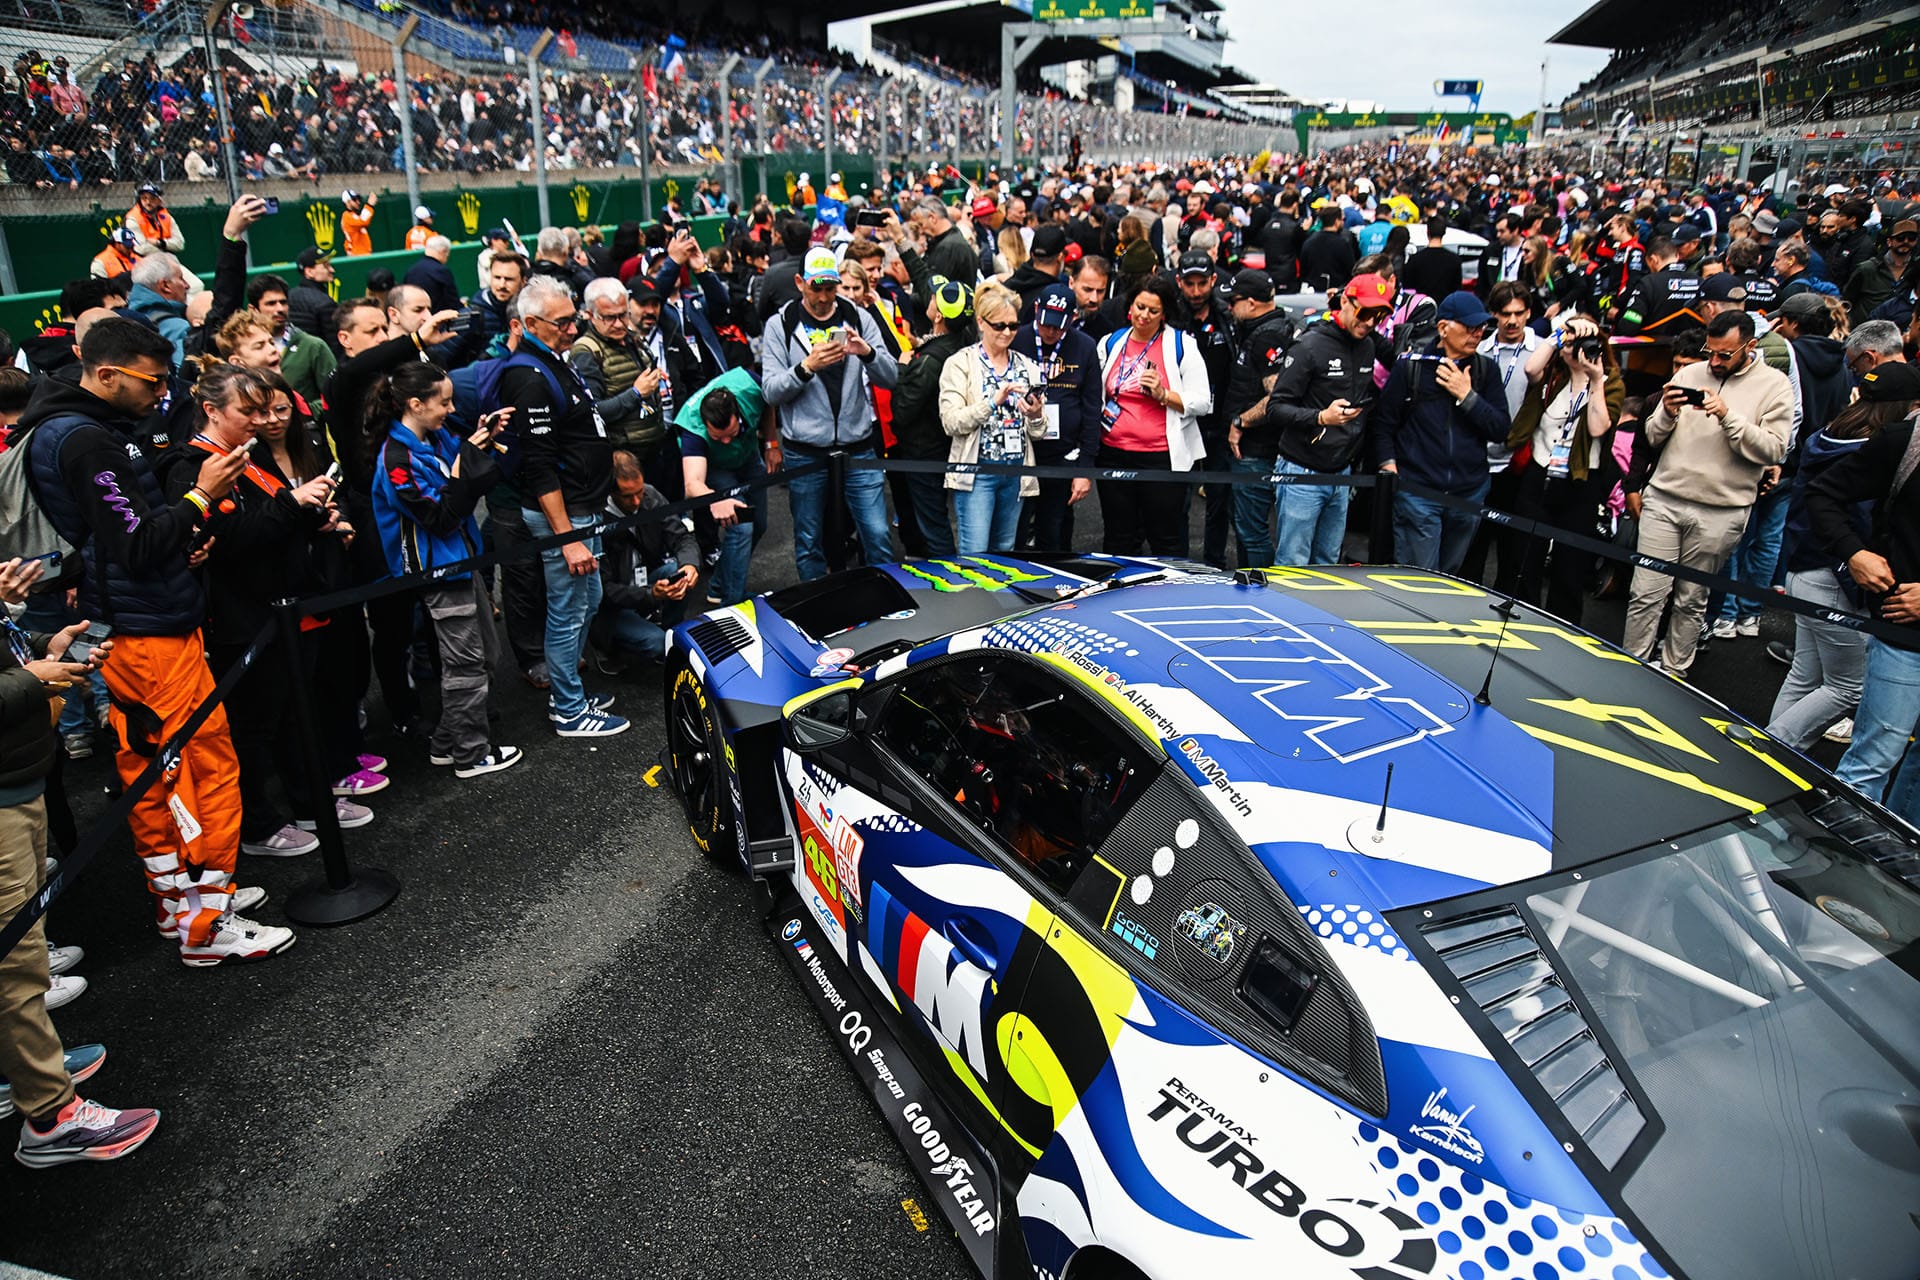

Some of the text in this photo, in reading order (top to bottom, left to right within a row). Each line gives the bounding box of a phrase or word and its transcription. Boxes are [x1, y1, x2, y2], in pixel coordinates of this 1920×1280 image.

[1111, 471, 1138, 479] WRT
[804, 835, 838, 902] 46
[839, 827, 858, 866] LM
[837, 854, 859, 896] GT3
[1116, 911, 1159, 949] GoPro
[807, 956, 848, 1011] Motorsport
[840, 1011, 872, 1056] OQ
[867, 1048, 906, 1099] Snap-on
[1165, 1077, 1259, 1146] PERTAMAX
[903, 1102, 995, 1237] GOODYEAR
[1147, 1088, 1365, 1258] TURBO
